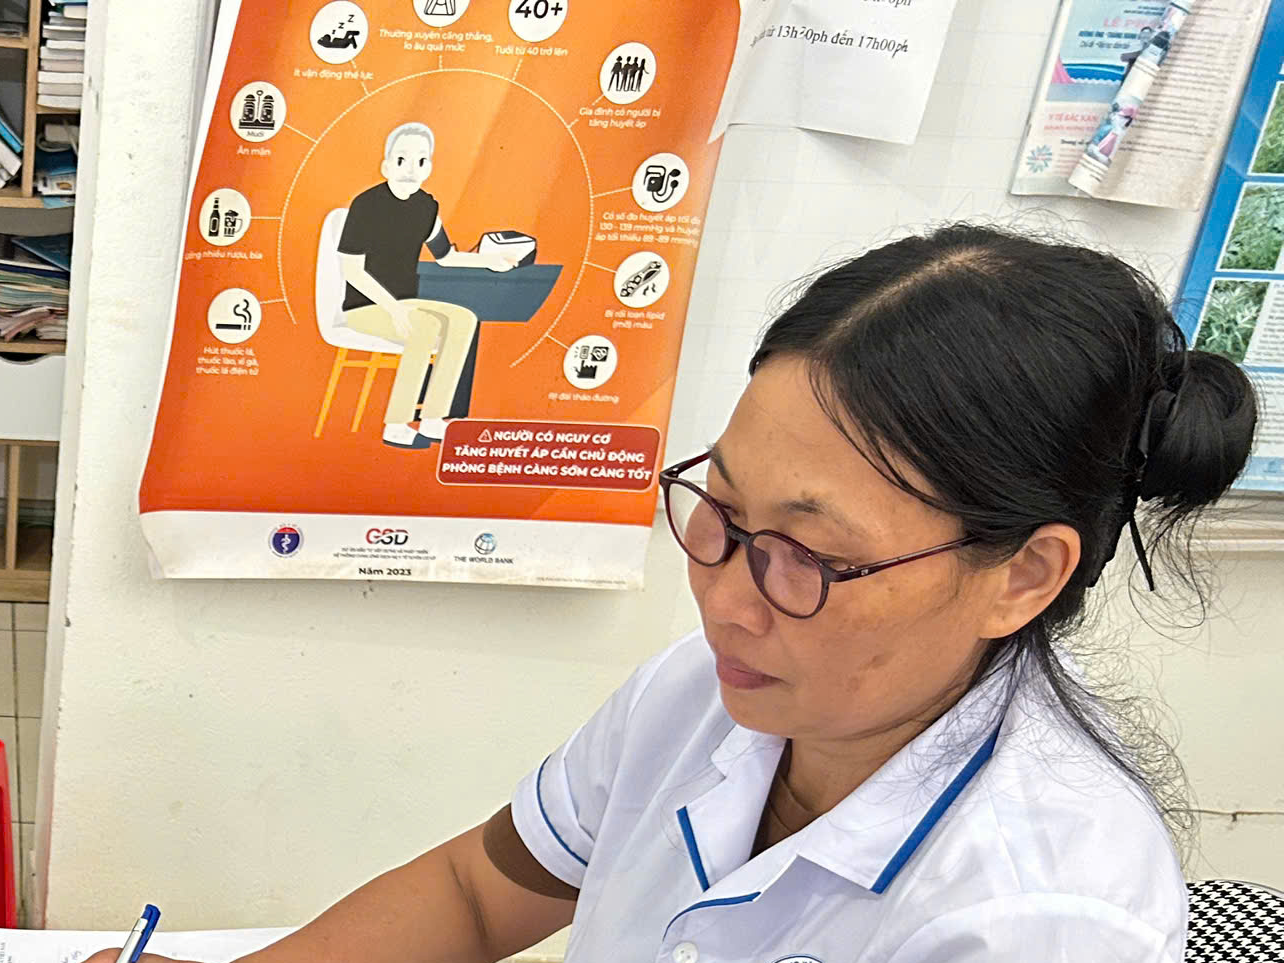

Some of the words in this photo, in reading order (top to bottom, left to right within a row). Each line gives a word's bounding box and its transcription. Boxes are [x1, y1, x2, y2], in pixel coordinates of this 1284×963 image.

[830, 30, 854, 46] đến
[527, 47, 539, 56] 40
[579, 107, 594, 116] Gia
[493, 429, 534, 442] NGƯỜI
[535, 431, 554, 443] CÓ
[556, 433, 590, 444] NGUY
[592, 433, 612, 445] CƠ
[454, 444, 488, 457] TĂNG
[490, 445, 530, 458] HUYẾT
[531, 446, 548, 459] ÁP
[579, 447, 605, 461] CHỦ
[608, 451, 645, 464] ĐỘNG
[442, 461, 486, 474] PHÒNG
[488, 462, 522, 476] BỆNH
[524, 462, 558, 475] CÀNG
[560, 465, 588, 476] SỚM
[590, 464, 625, 478] CÀNG
[627, 466, 653, 480] TỐT
[359, 567, 384, 576] Năm
[387, 568, 412, 577] 2023
